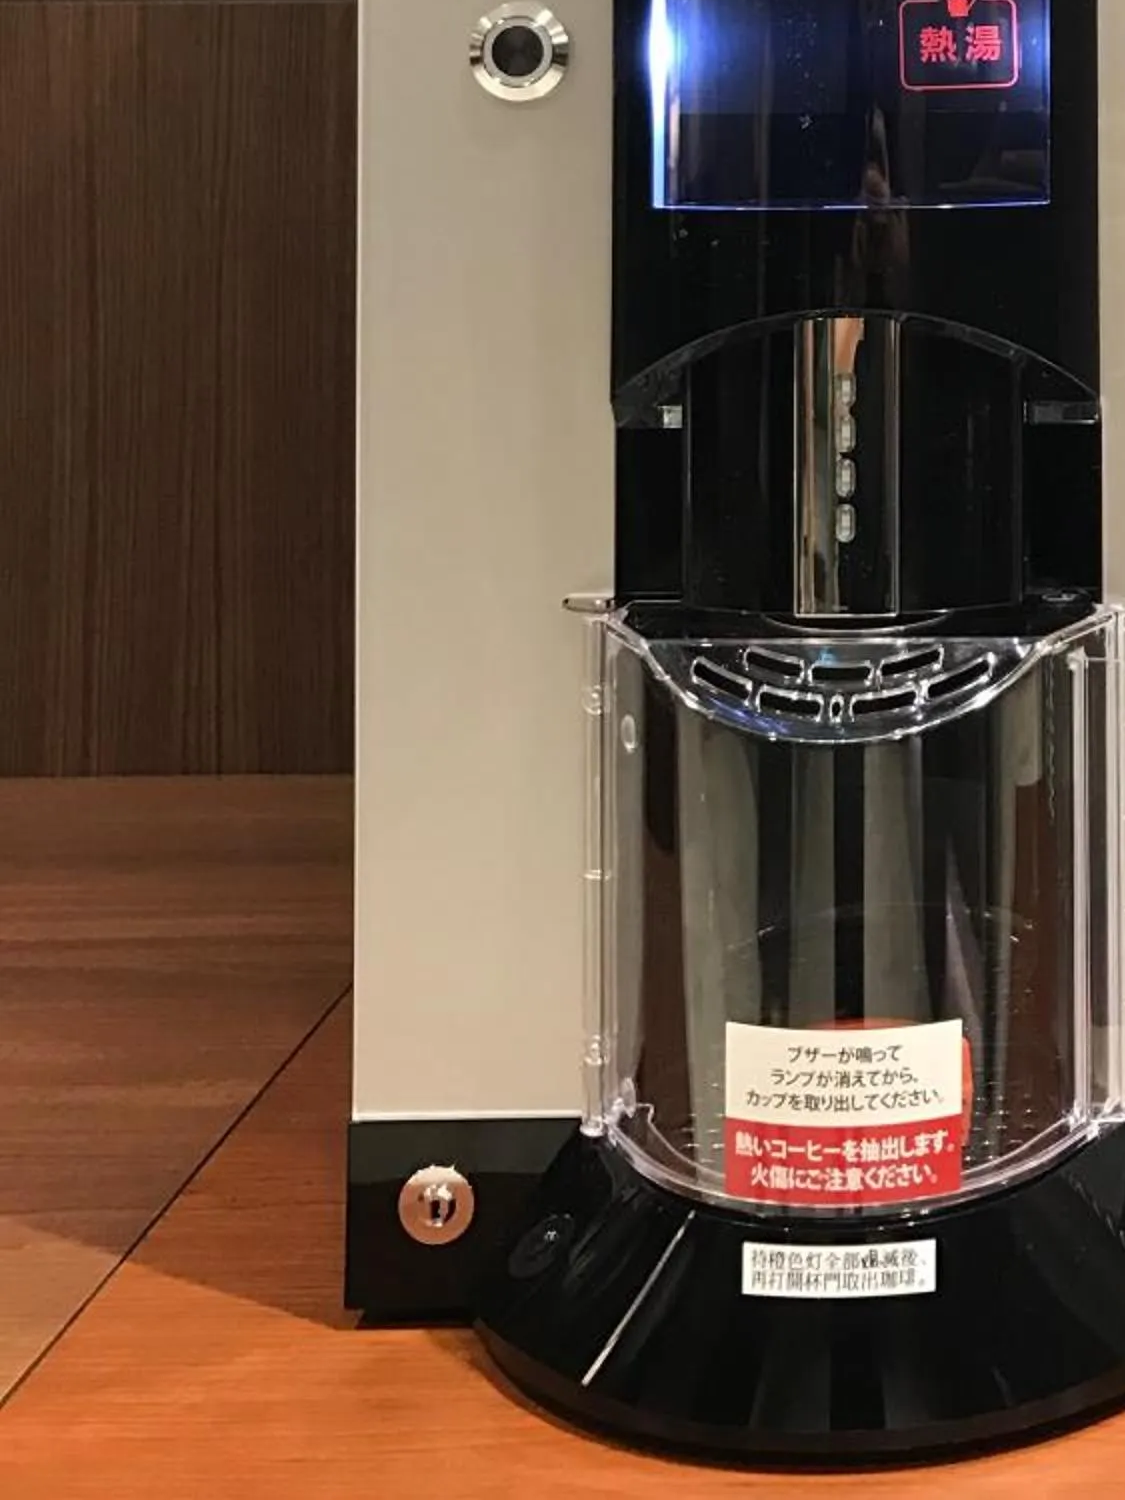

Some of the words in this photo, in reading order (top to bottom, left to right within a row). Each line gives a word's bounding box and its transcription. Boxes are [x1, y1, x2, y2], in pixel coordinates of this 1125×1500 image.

[919, 25, 1003, 63] 熱湯
[786, 1044, 904, 1064] ブザーが鳴って
[746, 1088, 945, 1113] カップを取り出してください。
[735, 1129, 955, 1162] 熱いコーヒーを抽出します。
[750, 1163, 938, 1192] 火傷にご注意ください。
